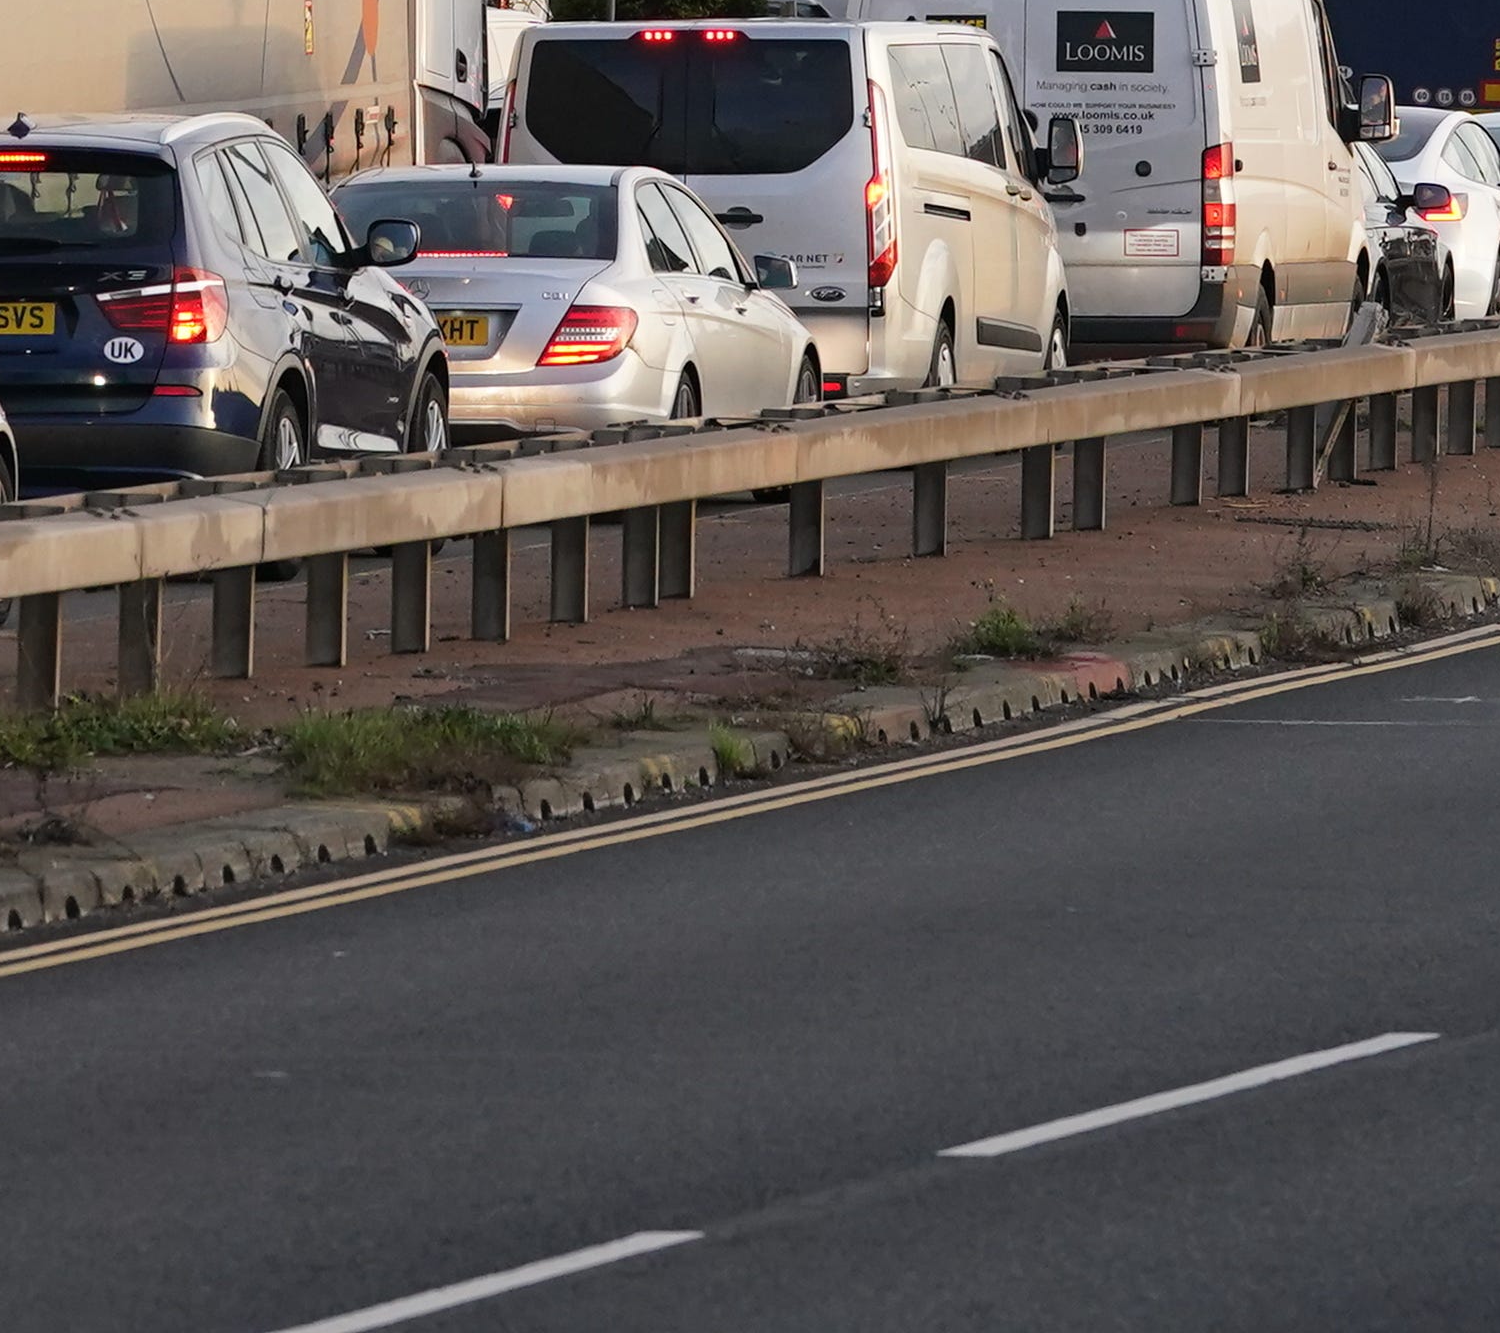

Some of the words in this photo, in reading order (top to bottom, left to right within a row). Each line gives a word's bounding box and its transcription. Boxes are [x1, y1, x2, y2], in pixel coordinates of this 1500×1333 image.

[1066, 42, 1144, 62] LOOMIS
[1036, 80, 1088, 93] Managing
[1090, 81, 1117, 91] cash
[1119, 82, 1128, 91] in
[1051, 111, 1155, 121] www.loomis.co.uk
[1093, 124, 1113, 134] 309
[1115, 124, 1143, 134] 6419
[806, 254, 828, 263] NET
[98, 269, 147, 282] X3
[110, 341, 135, 359] UK
